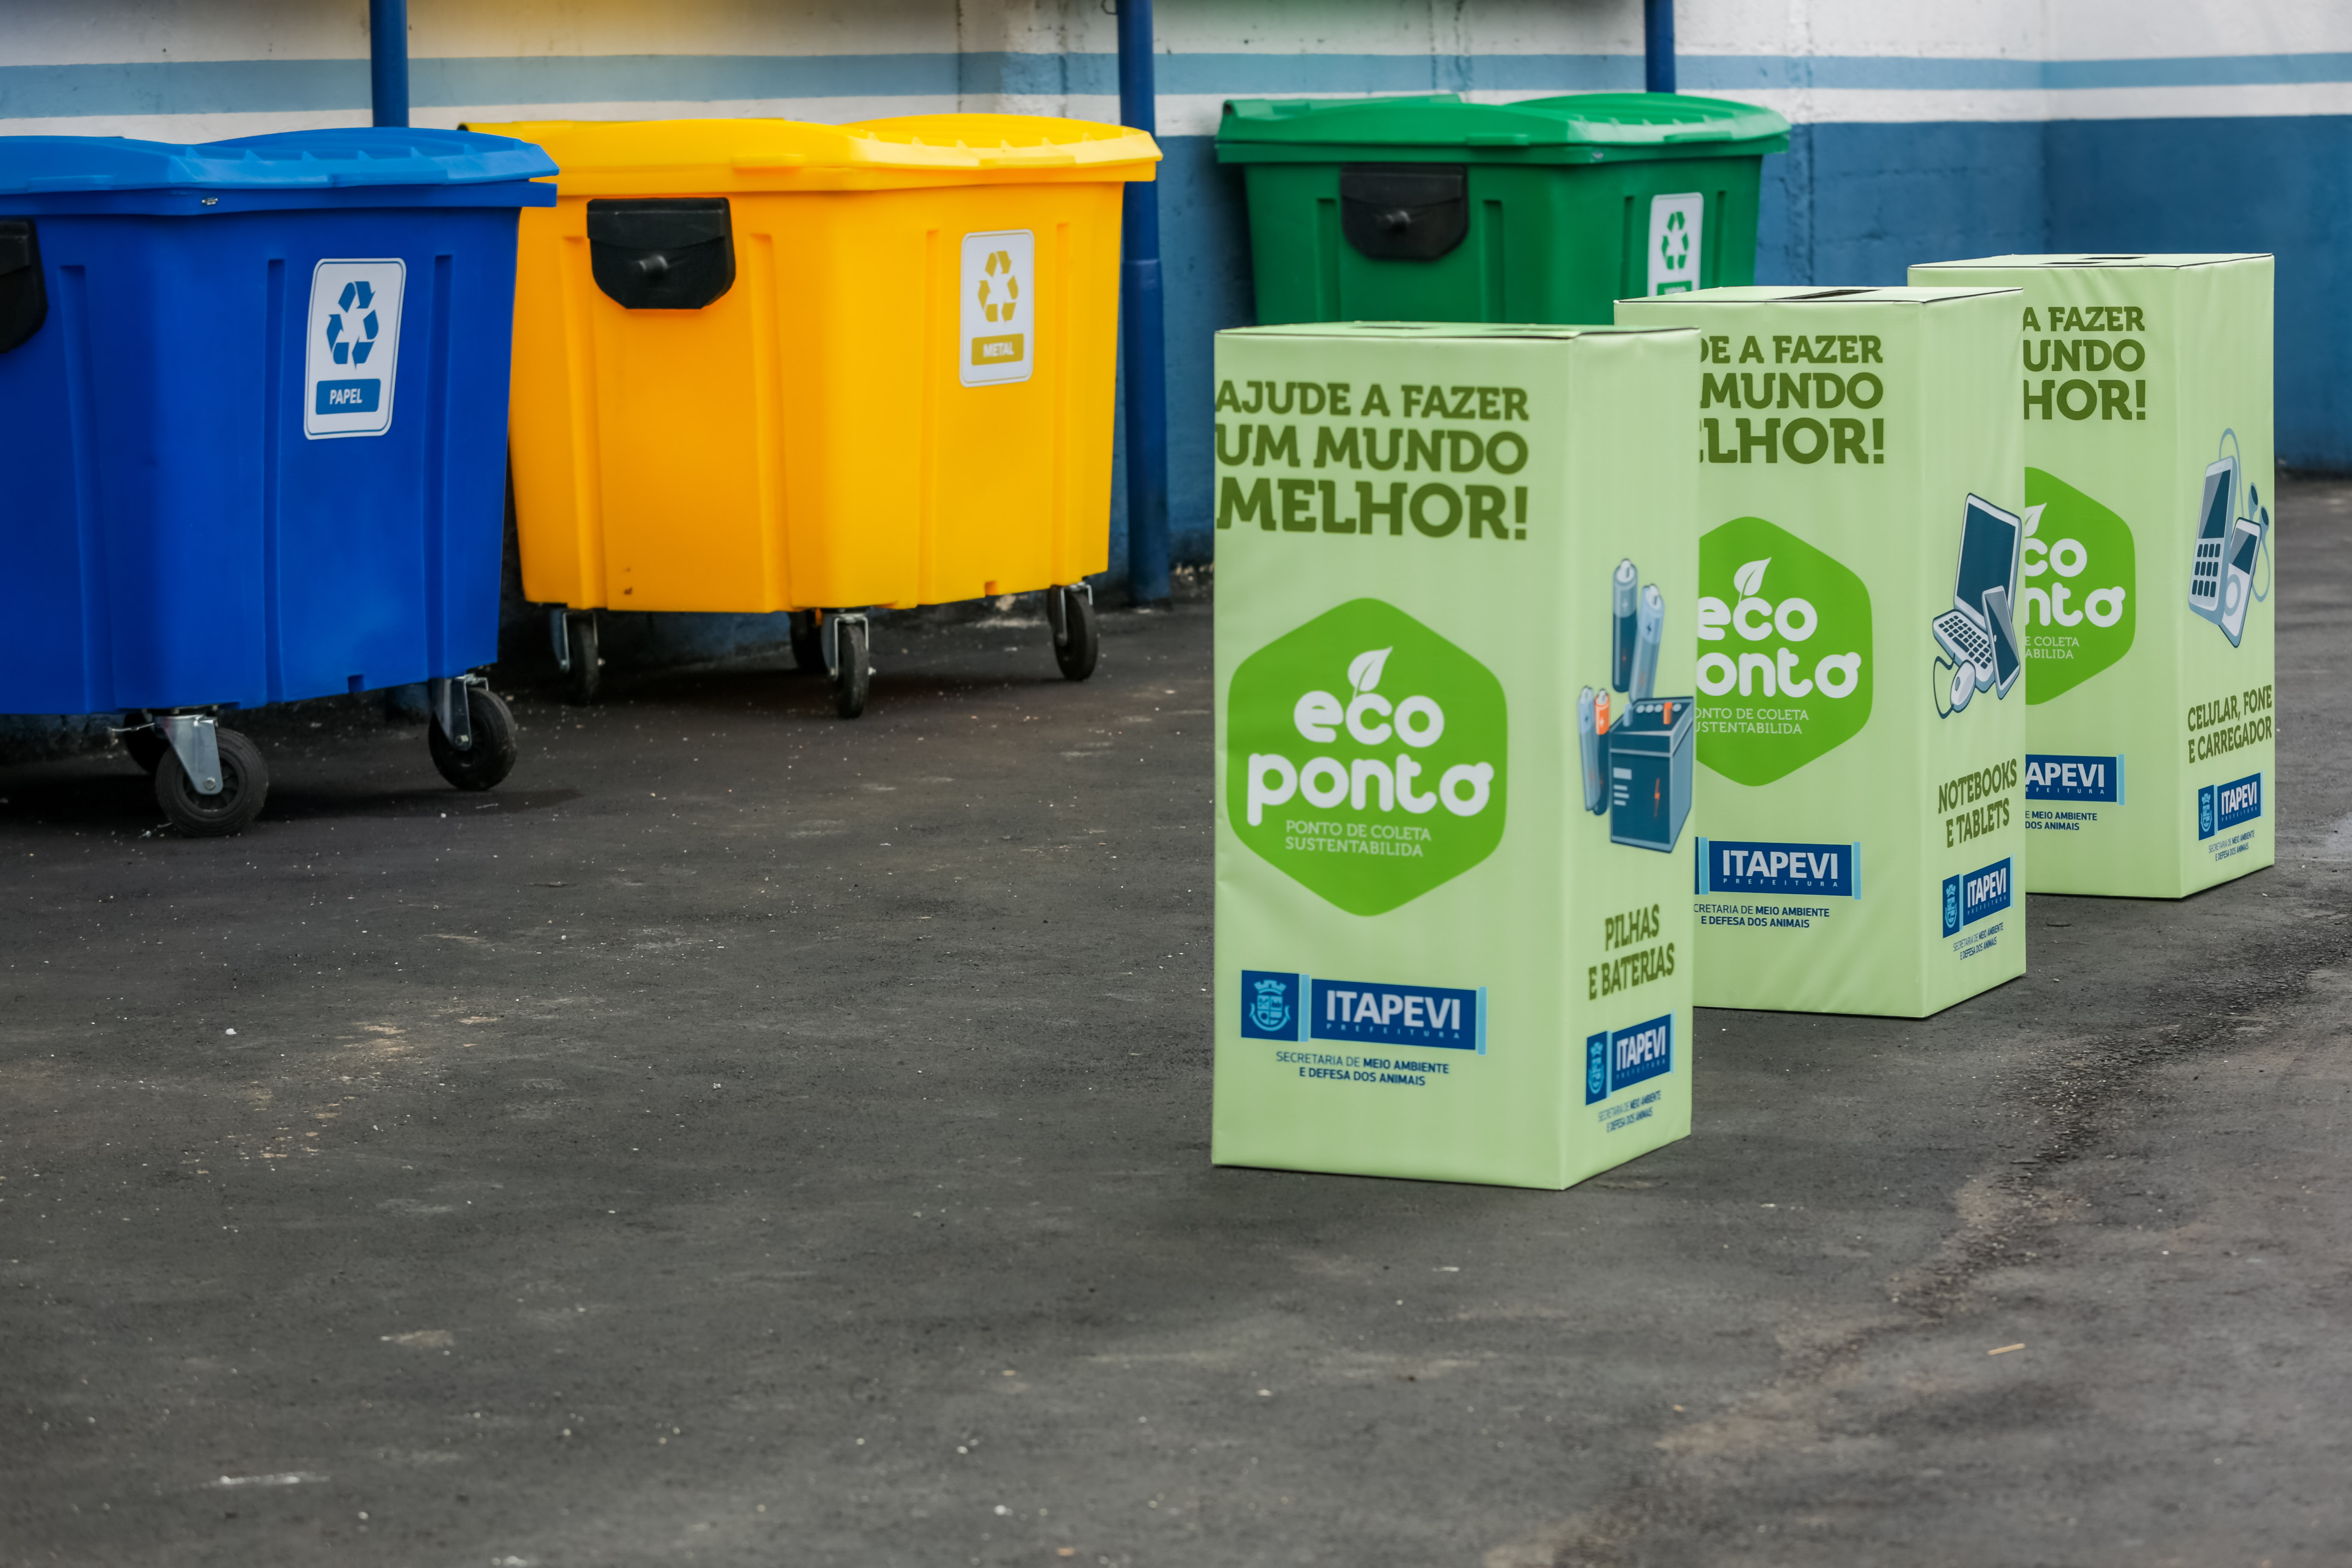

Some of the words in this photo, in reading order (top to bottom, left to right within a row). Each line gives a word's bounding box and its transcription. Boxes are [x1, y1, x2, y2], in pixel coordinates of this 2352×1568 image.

[2023, 306, 2041, 332] A
[2048, 306, 2145, 332] FAZER
[983, 342, 1015, 358] METAL
[1739, 336, 1764, 364] A
[1772, 335, 1883, 364] FAZER
[2023, 339, 2145, 372] UNDO
[329, 388, 363, 405] PAPEL
[1215, 379, 1352, 416] AJUDE
[1361, 383, 1390, 417] A
[1401, 384, 1529, 421] FAZER
[1700, 372, 1883, 409] MUNDO
[2024, 379, 2146, 420] HOR!
[1215, 423, 1301, 468] UM
[1314, 425, 1529, 475] MUNDO
[1700, 417, 1884, 464] LHOR!
[1216, 476, 1528, 541] MELHOR!
[2025, 538, 2087, 577] co
[1697, 596, 1818, 642] eco
[2025, 582, 2126, 628] nto
[2025, 636, 2031, 646] E
[2034, 636, 2080, 647] COLETA
[2025, 649, 2074, 659] ABILIDA
[1696, 647, 1861, 699] onto
[1293, 690, 1444, 747] eco
[1695, 708, 1732, 719] ONTO
[1736, 708, 1754, 719] DE
[1757, 709, 1809, 720] COLETA
[2188, 695, 2241, 732] CELULAR,
[2243, 684, 2272, 715] FONE
[1695, 721, 1802, 734] STENTABILIDA
[2188, 739, 2195, 764] E
[2197, 716, 2272, 761] CARREGADOR
[1247, 753, 1495, 826] ponto
[1938, 758, 2017, 814] NOTEBOOKS
[2025, 762, 2104, 787] APEVI
[2221, 781, 2257, 815] ITAPEVI
[1286, 820, 1343, 836] PONTO
[1347, 823, 1367, 837] DE
[1371, 824, 1432, 842] COLETA
[1946, 818, 1954, 848] E
[1956, 797, 2010, 844] TABLETS
[2025, 821, 2042, 830] DOS
[2044, 822, 2080, 830] ANIMAIS
[2032, 811, 2053, 819] MEIO
[2054, 812, 2097, 821] AMBIENTE
[1285, 836, 1423, 857] SUSTENTABILIDA
[2232, 835, 2240, 845] MEIO
[2240, 830, 2255, 842] AMBIENTE
[1723, 850, 1838, 879] ITAPEVI
[1723, 878, 1838, 888] PREFEITURA
[1967, 867, 2007, 908] ITAPEVI
[1694, 904, 1739, 914] CRETARIA
[1741, 905, 1753, 914] DE
[1756, 906, 1779, 916] MEIO
[1782, 907, 1830, 917] AMBIENTE
[1701, 916, 1707, 925] E
[1709, 916, 1745, 926] DEFESA
[1748, 917, 1767, 927] DOS
[1769, 918, 1810, 928] ANIMAIS
[1605, 904, 1659, 952] PILHAS
[1953, 937, 1974, 952] SECRETARIA
[1974, 933, 1978, 943] DE
[1978, 930, 1987, 940] MEIO
[1987, 922, 2004, 937] AMBIENTE
[1963, 946, 1976, 959] DEFESA
[1983, 936, 1997, 950] ANIMAIS
[1588, 966, 1597, 1001] E
[1602, 942, 1675, 997] BATERIAS
[1327, 990, 1460, 1030] ITAPEVI
[1327, 1023, 1459, 1039] PREFEITURA
[1276, 1051, 1343, 1066] SECRETARIA
[1346, 1056, 1360, 1067] DE
[1363, 1057, 1390, 1069] MEIO
[1393, 1060, 1449, 1074] AMBIENTE
[1616, 1025, 1666, 1071] ITAPEVI
[1299, 1067, 1306, 1077] E
[1308, 1068, 1350, 1080] DEFESA
[1354, 1071, 1376, 1082] DOS
[1379, 1073, 1425, 1086] ANIMAIS
